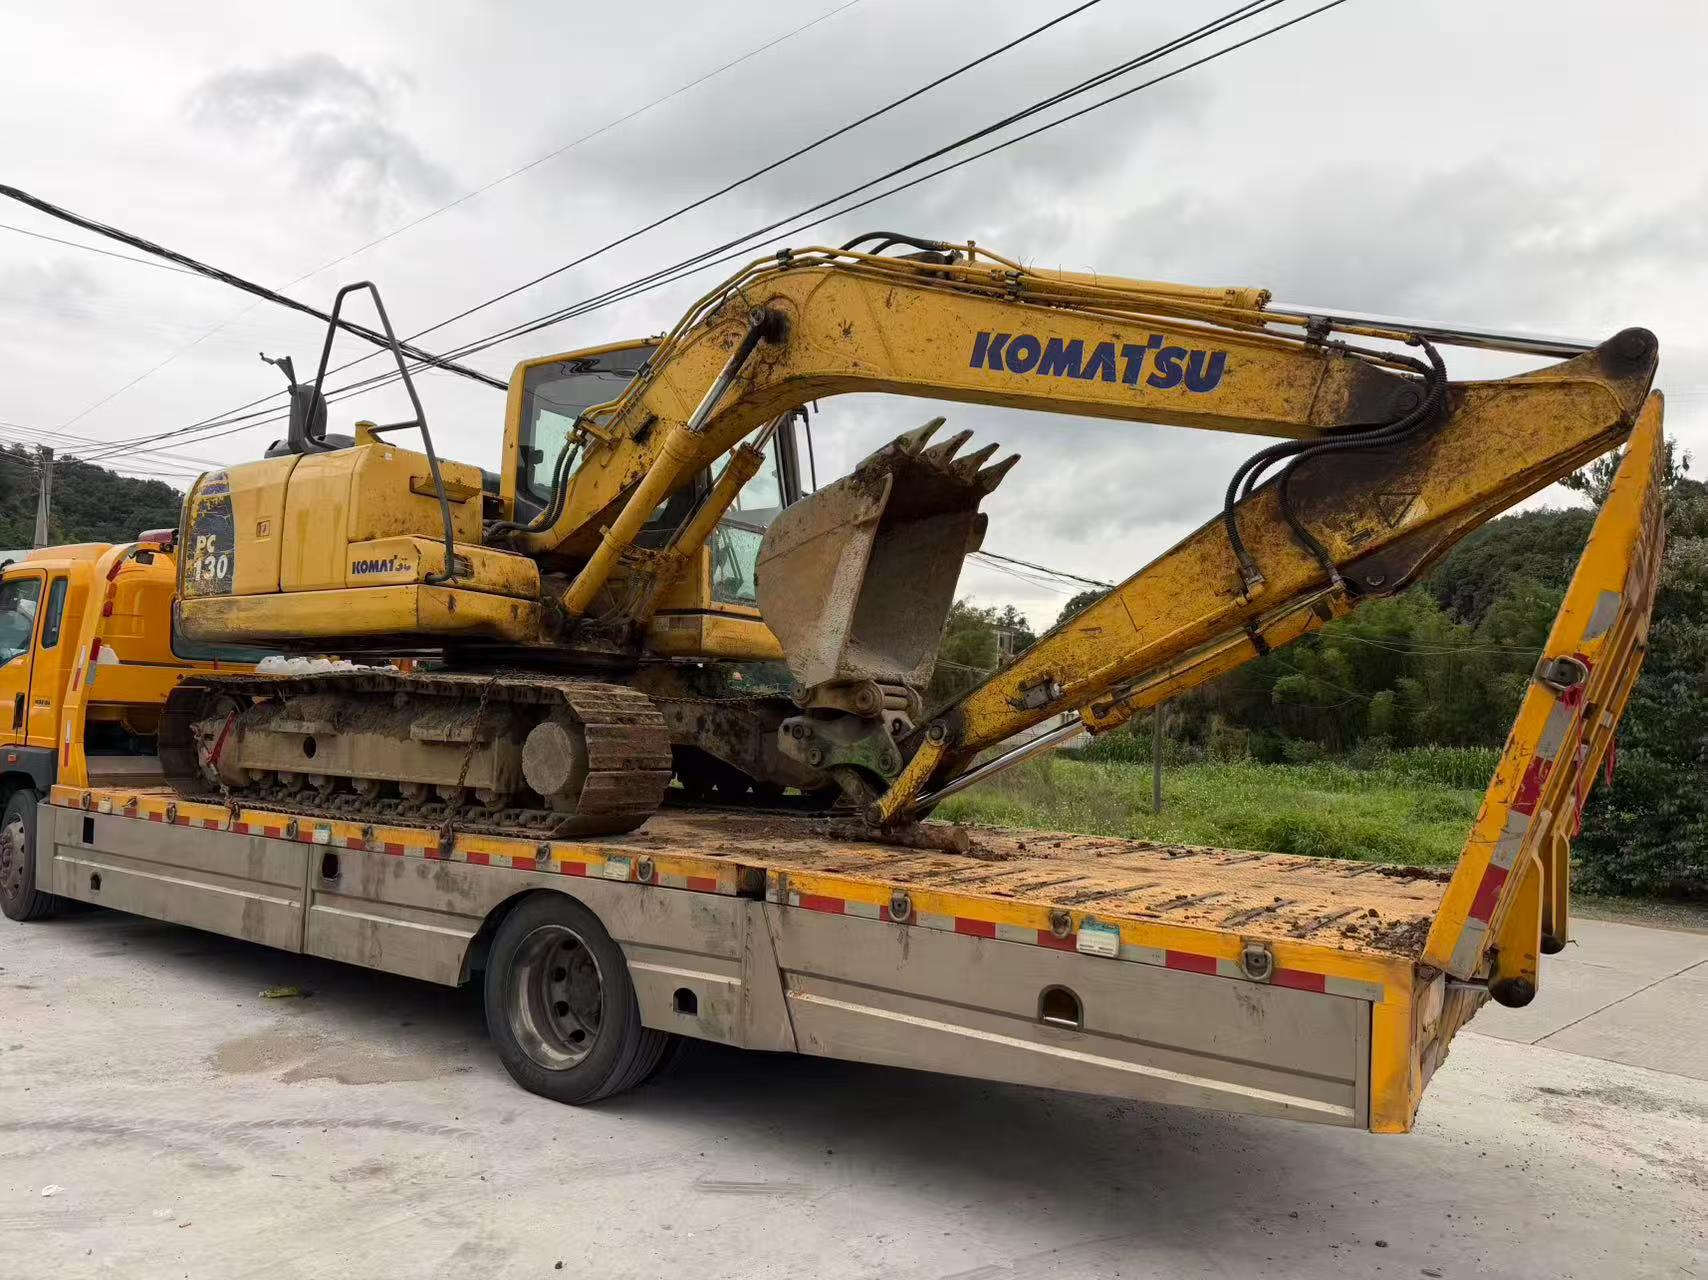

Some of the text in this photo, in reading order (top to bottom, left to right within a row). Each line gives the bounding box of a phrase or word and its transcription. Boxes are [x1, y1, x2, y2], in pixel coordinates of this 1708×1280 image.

[969, 331, 1227, 393] KOMATSU
[195, 535, 217, 553] PC
[194, 555, 228, 580] 130
